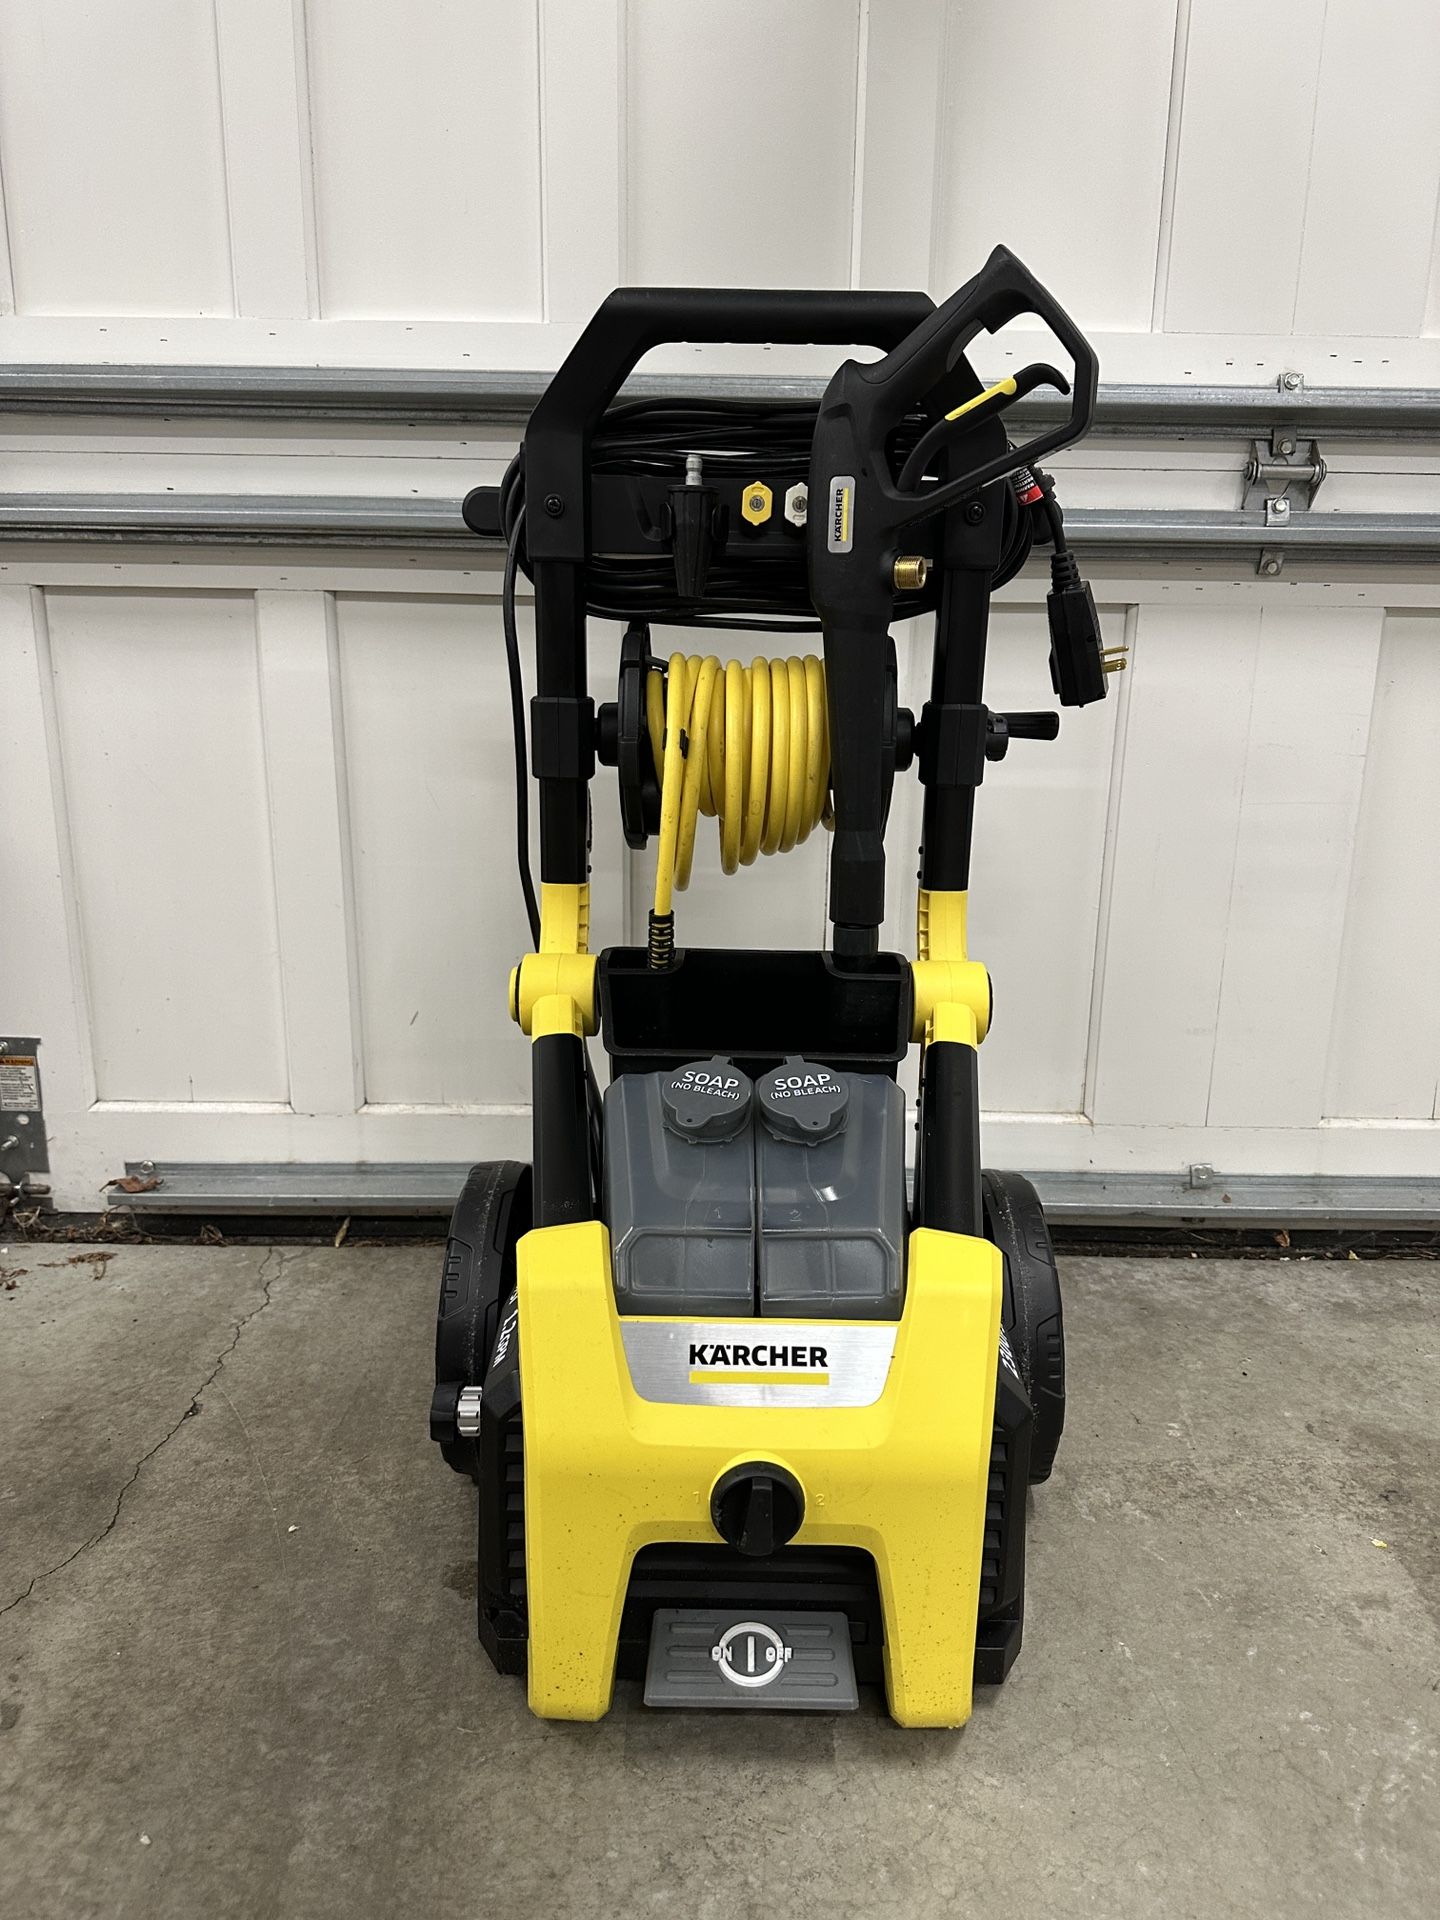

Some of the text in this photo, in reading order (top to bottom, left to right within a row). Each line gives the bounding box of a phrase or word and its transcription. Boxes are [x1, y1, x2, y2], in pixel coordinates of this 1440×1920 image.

[682, 1071, 739, 1090] SOAP
[774, 1073, 831, 1091] SOAP
[671, 1081, 740, 1100] (NO BLEACH)
[770, 1085, 841, 1100] (NO BLEACH)
[689, 1344, 828, 1367] KÄRCHER
[815, 1493, 825, 1506] 2
[711, 1646, 732, 1661] ON
